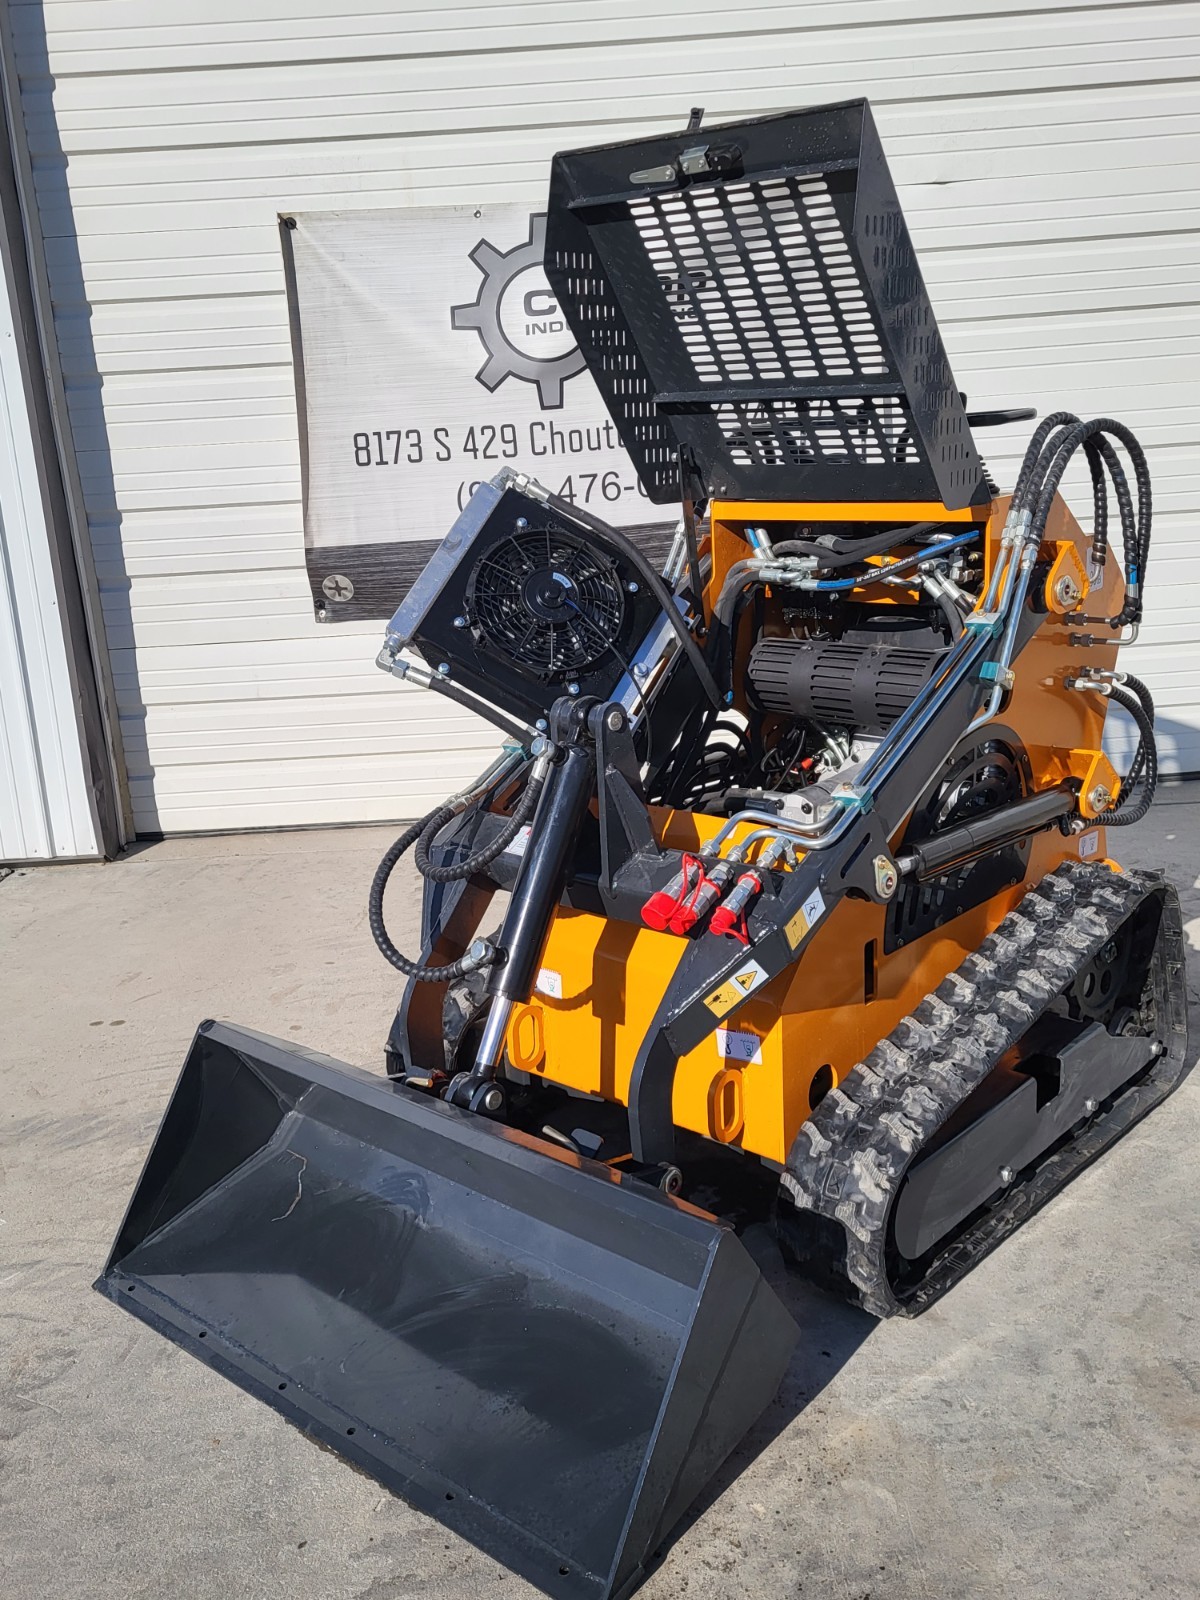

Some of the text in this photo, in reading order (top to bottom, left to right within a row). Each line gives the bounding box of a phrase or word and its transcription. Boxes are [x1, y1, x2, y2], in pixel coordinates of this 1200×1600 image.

[353, 430, 423, 467] 8173
[433, 427, 451, 462] S
[463, 425, 519, 460] 429
